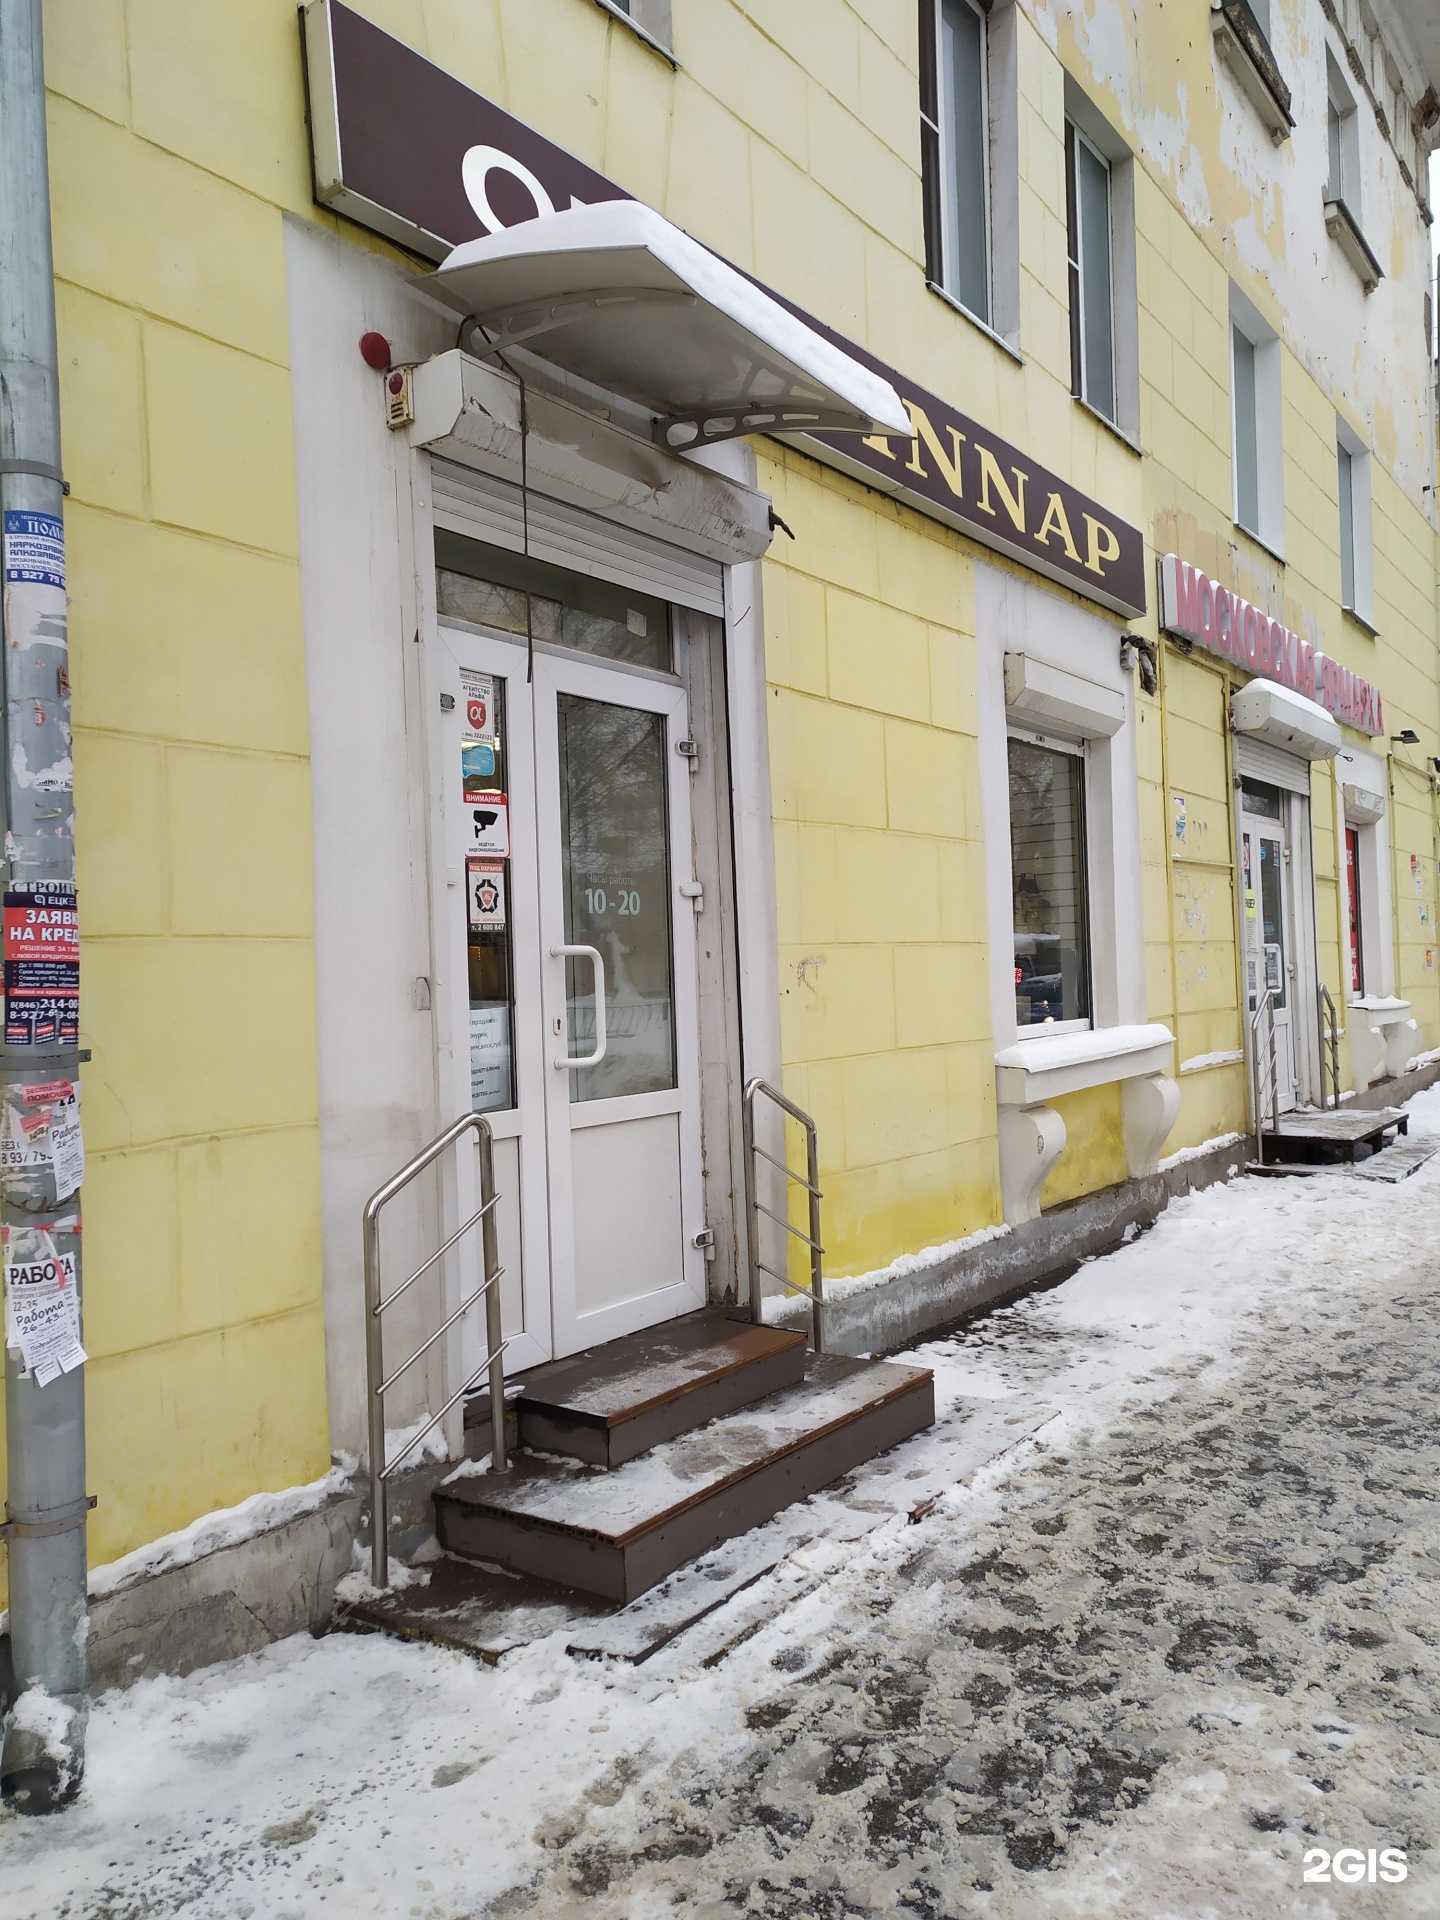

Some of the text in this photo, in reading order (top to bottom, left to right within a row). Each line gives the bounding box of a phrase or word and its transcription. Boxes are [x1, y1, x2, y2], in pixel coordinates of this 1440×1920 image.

[466, 793, 502, 803] ВНИМАНИЕ
[10, 927, 35, 941] НА
[9, 1257, 74, 1285] РАБОА
